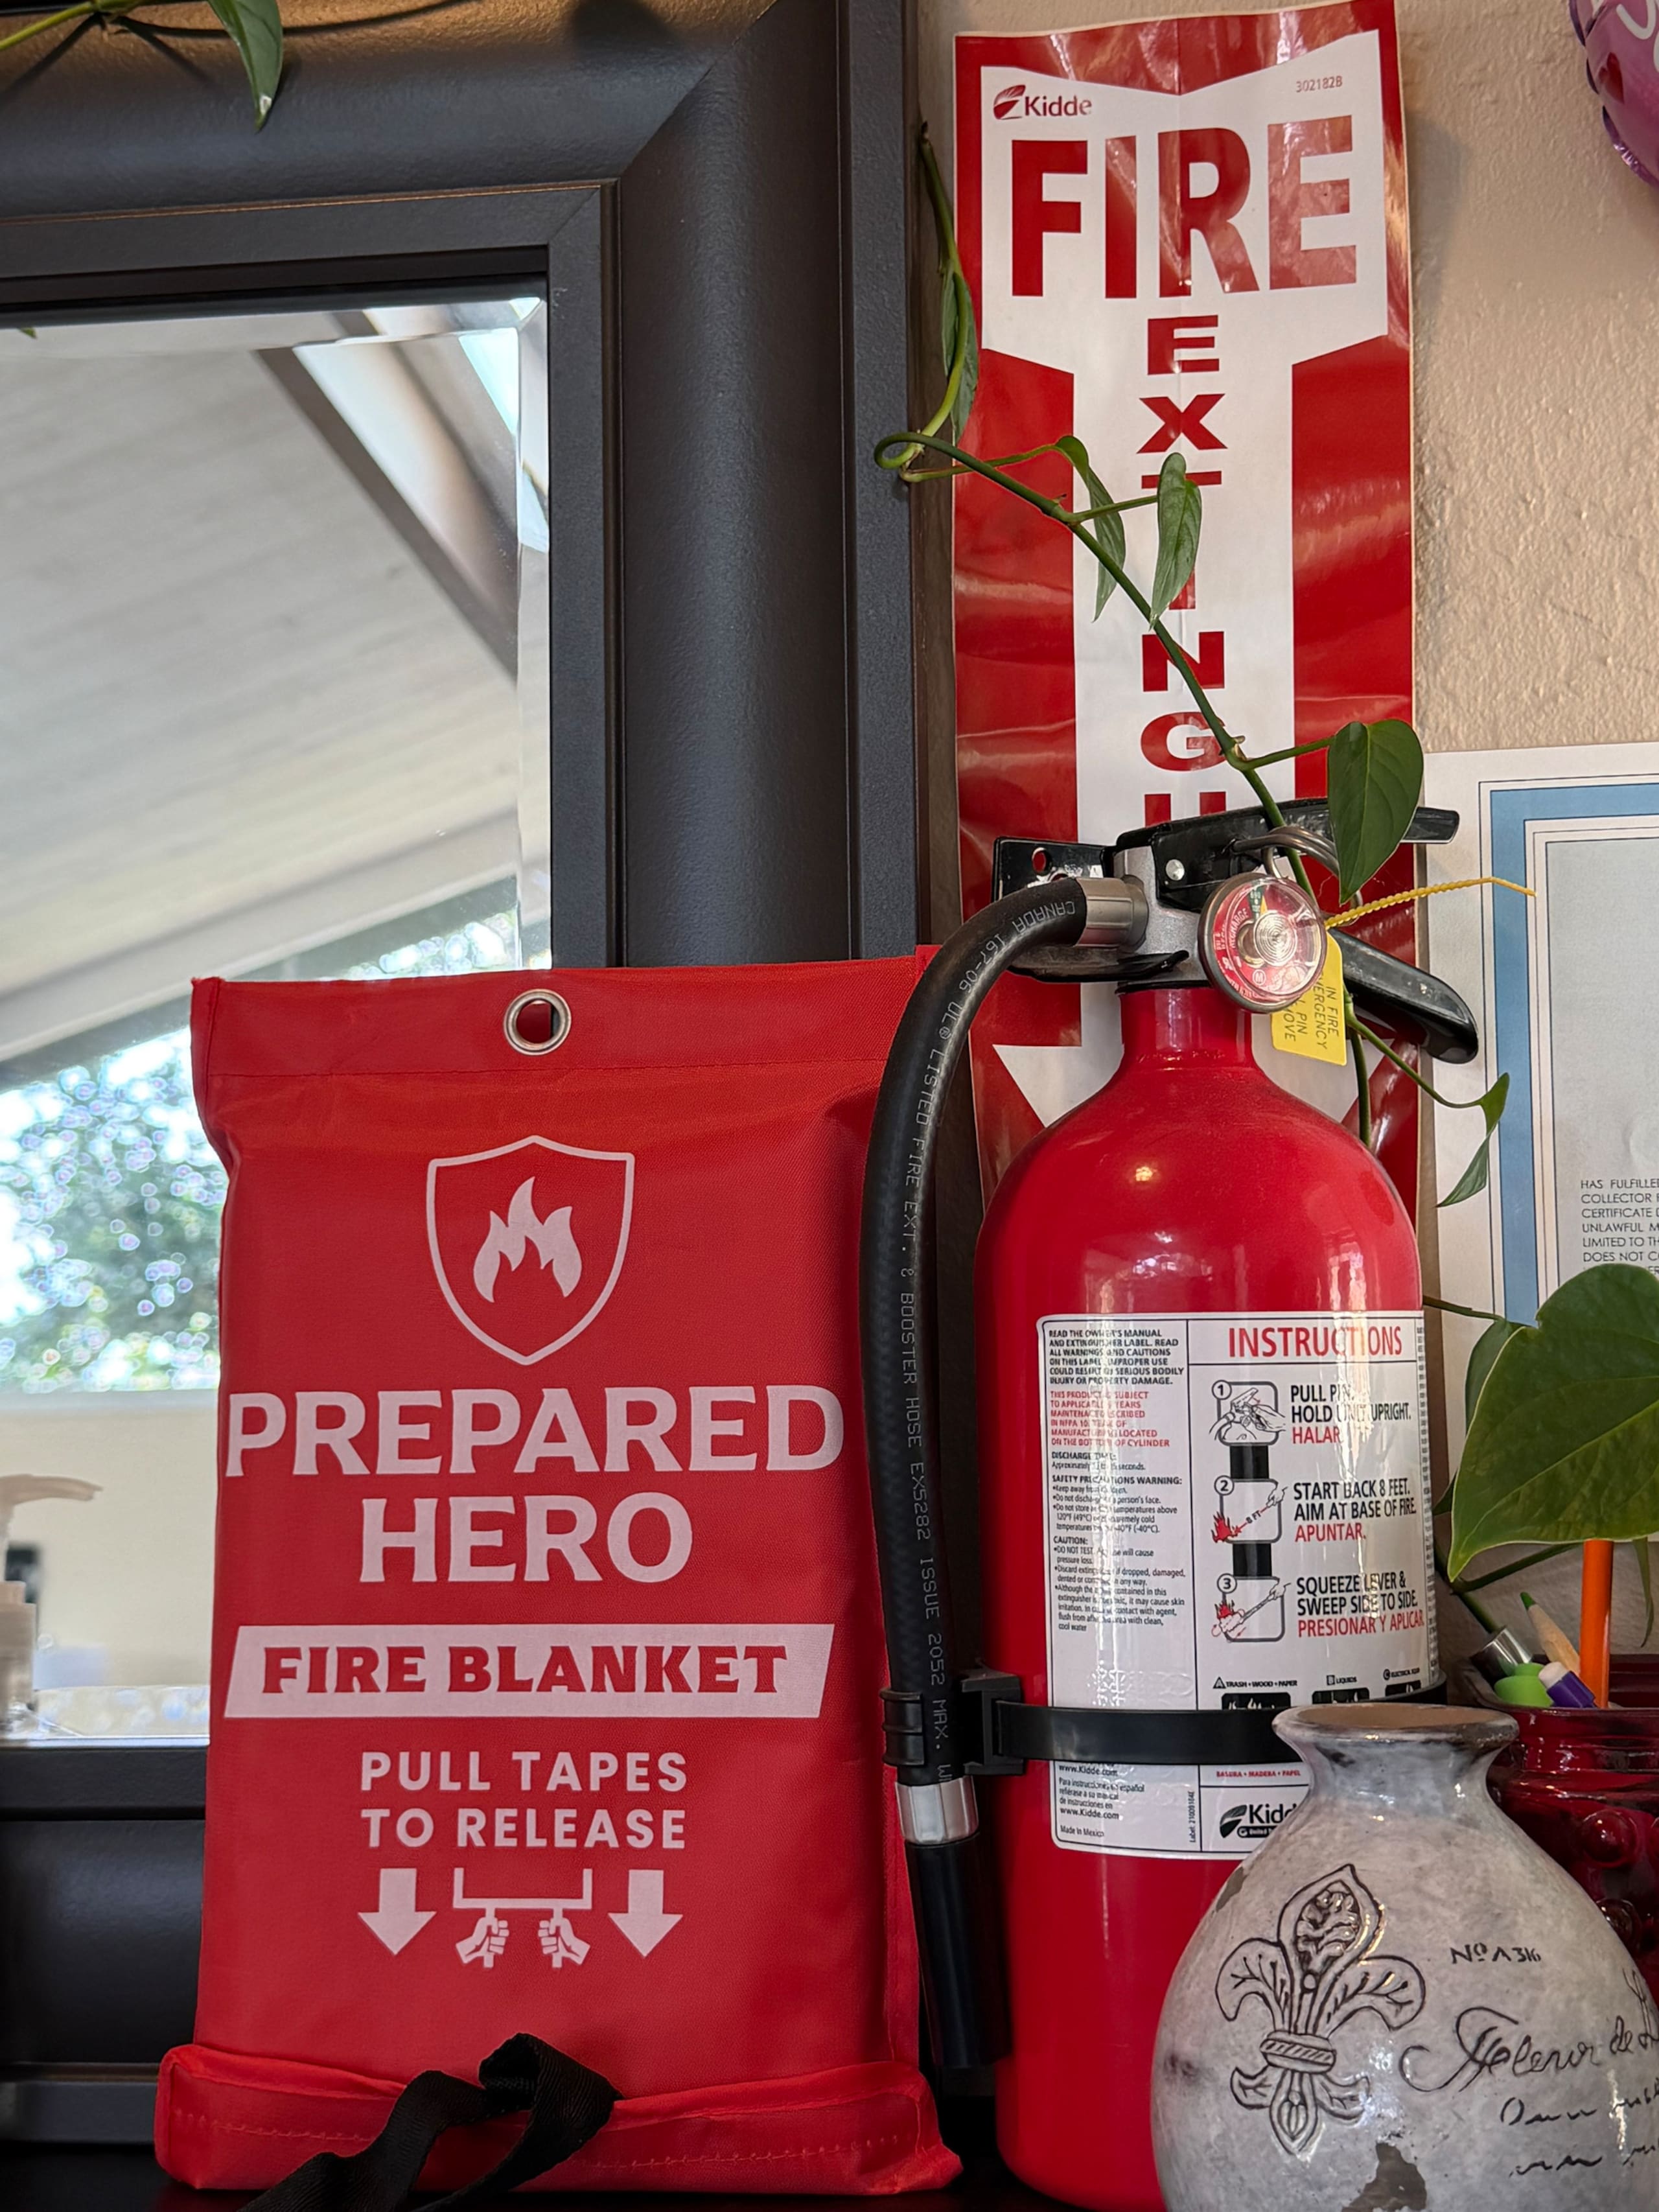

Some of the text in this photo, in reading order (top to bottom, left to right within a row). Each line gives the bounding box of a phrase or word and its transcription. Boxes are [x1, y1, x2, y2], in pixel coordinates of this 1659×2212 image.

[1295, 76, 1343, 93] 302182B
[1025, 95, 1092, 117] Kidde
[1011, 115, 1357, 299] FIRE
[1012, 900, 1075, 934] CANADA
[1313, 973, 1328, 1050] ERGENCY
[1326, 986, 1339, 1038] IN FIRE
[1296, 1011, 1308, 1035] PIN
[915, 1049, 945, 1126] LISTED
[905, 1137, 925, 1187] FIRE
[1581, 1180, 1603, 1189] HAS
[1581, 1193, 1652, 1204] COLLECTOR
[1581, 1208, 1652, 1218] CERTIFICATE
[1583, 1222, 1643, 1233] UNLAWFUL
[1583, 1237, 1626, 1247] LIMITED
[1630, 1237, 1644, 1246] TO
[1583, 1252, 1615, 1262] DOES
[1619, 1252, 1643, 1261] NOT
[899, 1292, 918, 1385] BOOSTER
[1229, 1326, 1402, 1357] INSTRUCTIONS
[1217, 1384, 1224, 1395] 1
[1291, 1384, 1326, 1403] PULL
[905, 1397, 922, 1448] HOSE
[1292, 1405, 1332, 1424] HOLD
[1371, 1403, 1411, 1422] UPRIGHT.
[226, 1384, 844, 1477] PREPARED
[1220, 1480, 1228, 1491] 2
[1294, 1478, 1410, 1501] START BACK 8 FEET.
[910, 1461, 931, 1541] EX5282
[1294, 1502, 1323, 1521] AIM
[1329, 1502, 1347, 1520] AT
[1352, 1501, 1381, 1519] BASE
[1384, 1500, 1397, 1517] OF
[360, 1491, 693, 1583] HERO
[1054, 1536, 1088, 1544] CAUTION:
[1295, 1523, 1366, 1543] APUNTAR.
[1152, 1569, 1185, 1578] damaged,
[1223, 1578, 1231, 1589] 3
[920, 1557, 940, 1620] ISSUE
[1296, 1575, 1360, 1596] SQUEEZE
[1297, 1597, 1347, 1616] SWEEP
[1382, 1594, 1395, 1611] TO
[1298, 1616, 1376, 1638] PRESIONAR
[1379, 1616, 1387, 1633] Y
[262, 1644, 788, 1694] FIRE BLANKET
[928, 1633, 946, 1686] 2052
[360, 1751, 687, 1792] PULL TAPES
[1249, 1803, 1297, 1824] Kid
[360, 1808, 686, 1848] TO RELEASE
